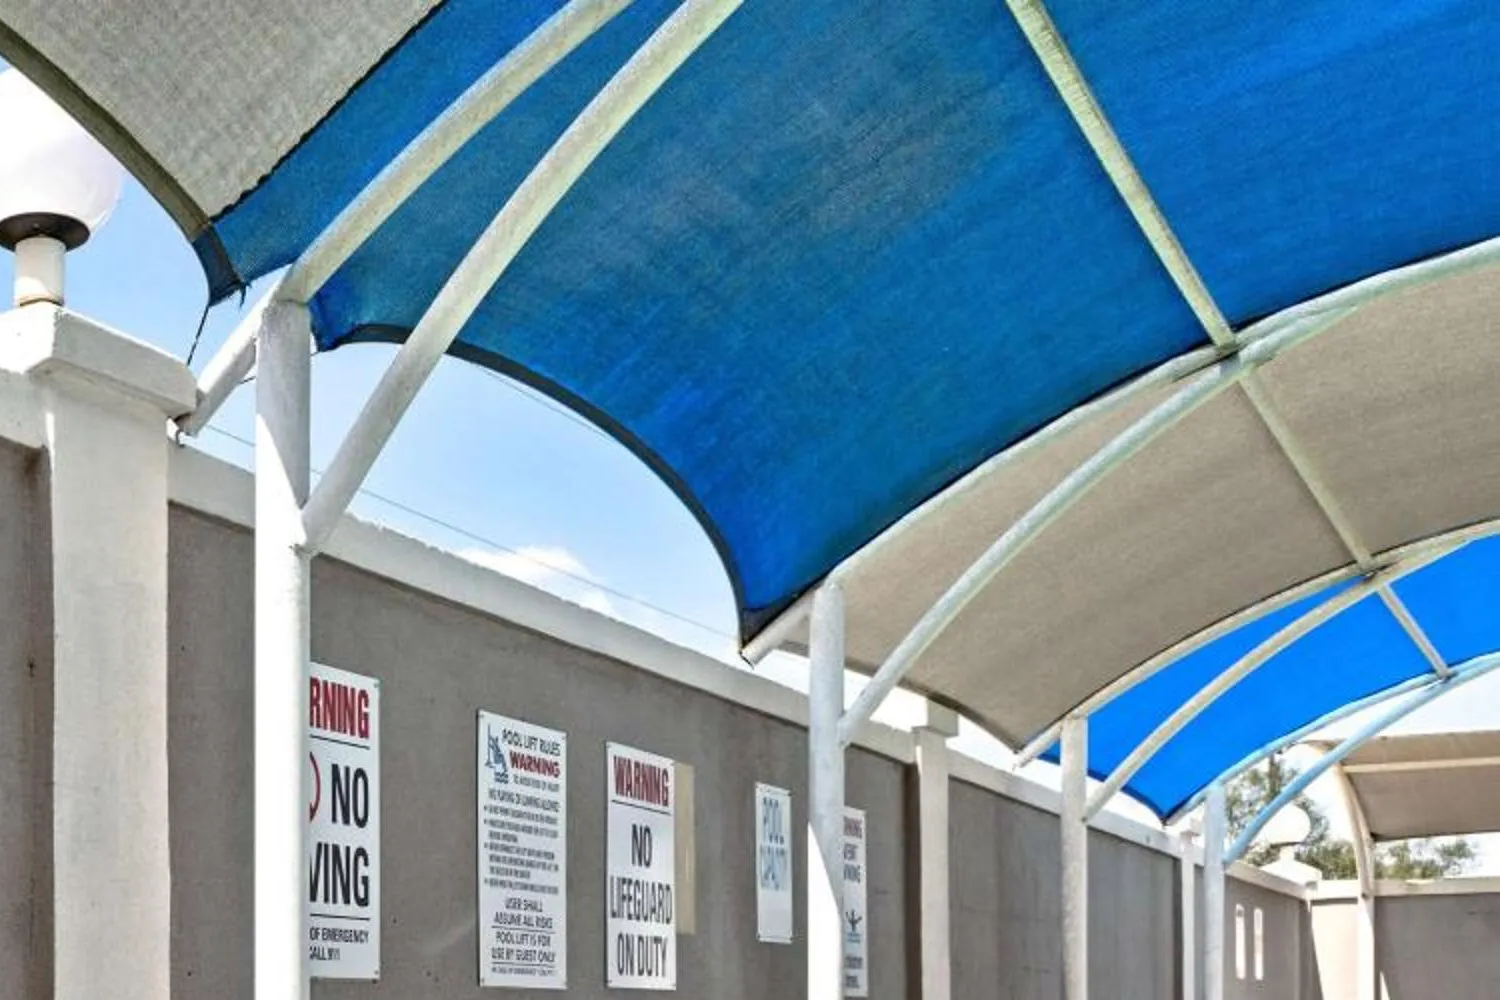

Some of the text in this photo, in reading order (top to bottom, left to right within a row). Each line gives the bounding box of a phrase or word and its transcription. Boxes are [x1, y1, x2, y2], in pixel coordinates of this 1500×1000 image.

[308, 675, 370, 740] RNING
[508, 749, 561, 779] WARNING
[613, 754, 670, 808] WARNING
[330, 762, 370, 829] NO
[631, 823, 653, 869] NO
[308, 841, 370, 909] VING
[610, 875, 673, 926] LIFEGUARD
[321, 927, 370, 944] EMERGENCY
[616, 931, 669, 979] ON DUTY
